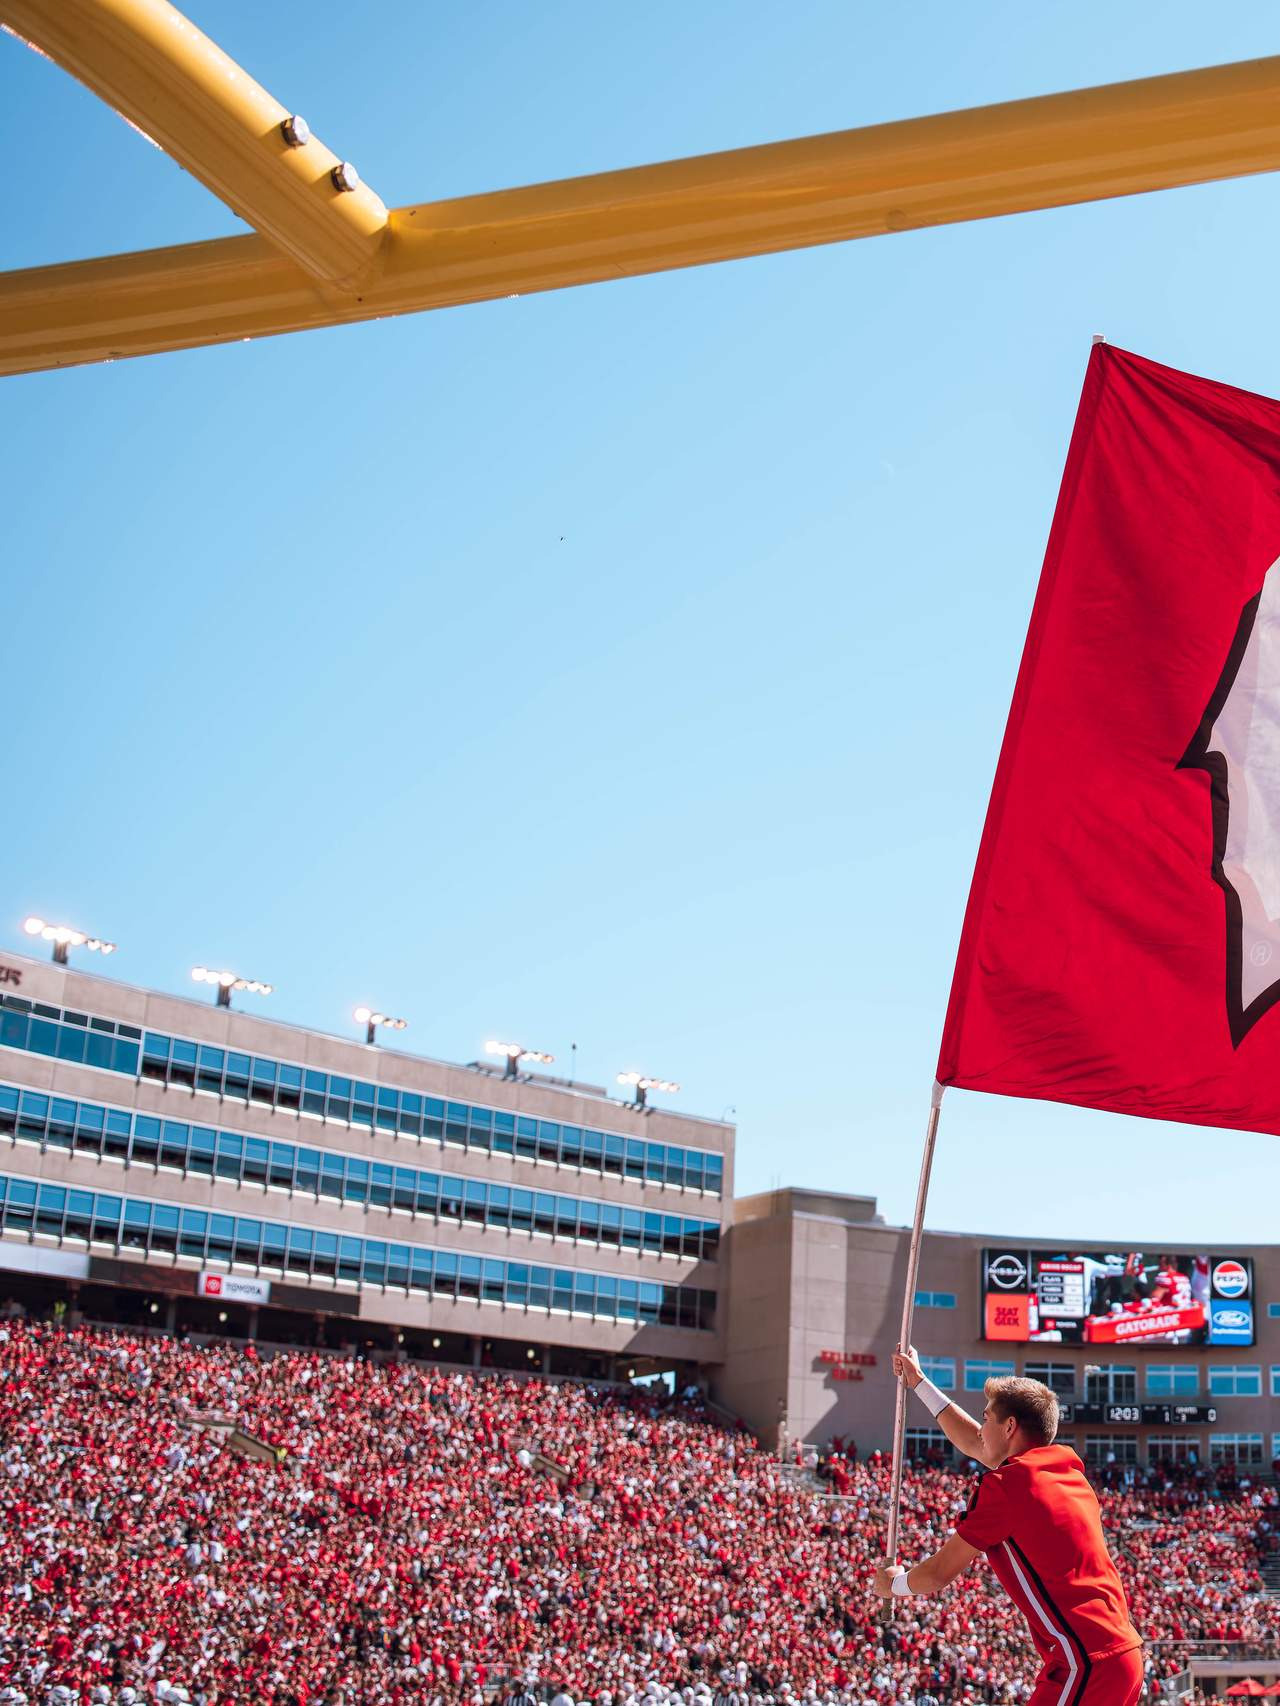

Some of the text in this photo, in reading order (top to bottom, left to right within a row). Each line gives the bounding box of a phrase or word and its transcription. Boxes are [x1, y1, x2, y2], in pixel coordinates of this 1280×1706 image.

[1217, 1275, 1244, 1283] PEPSI
[225, 1281, 262, 1296] TOYOTA
[995, 1306, 1019, 1317] SEAT
[994, 1316, 1019, 1327] GEEK
[1115, 1313, 1180, 1336] GATORADE
